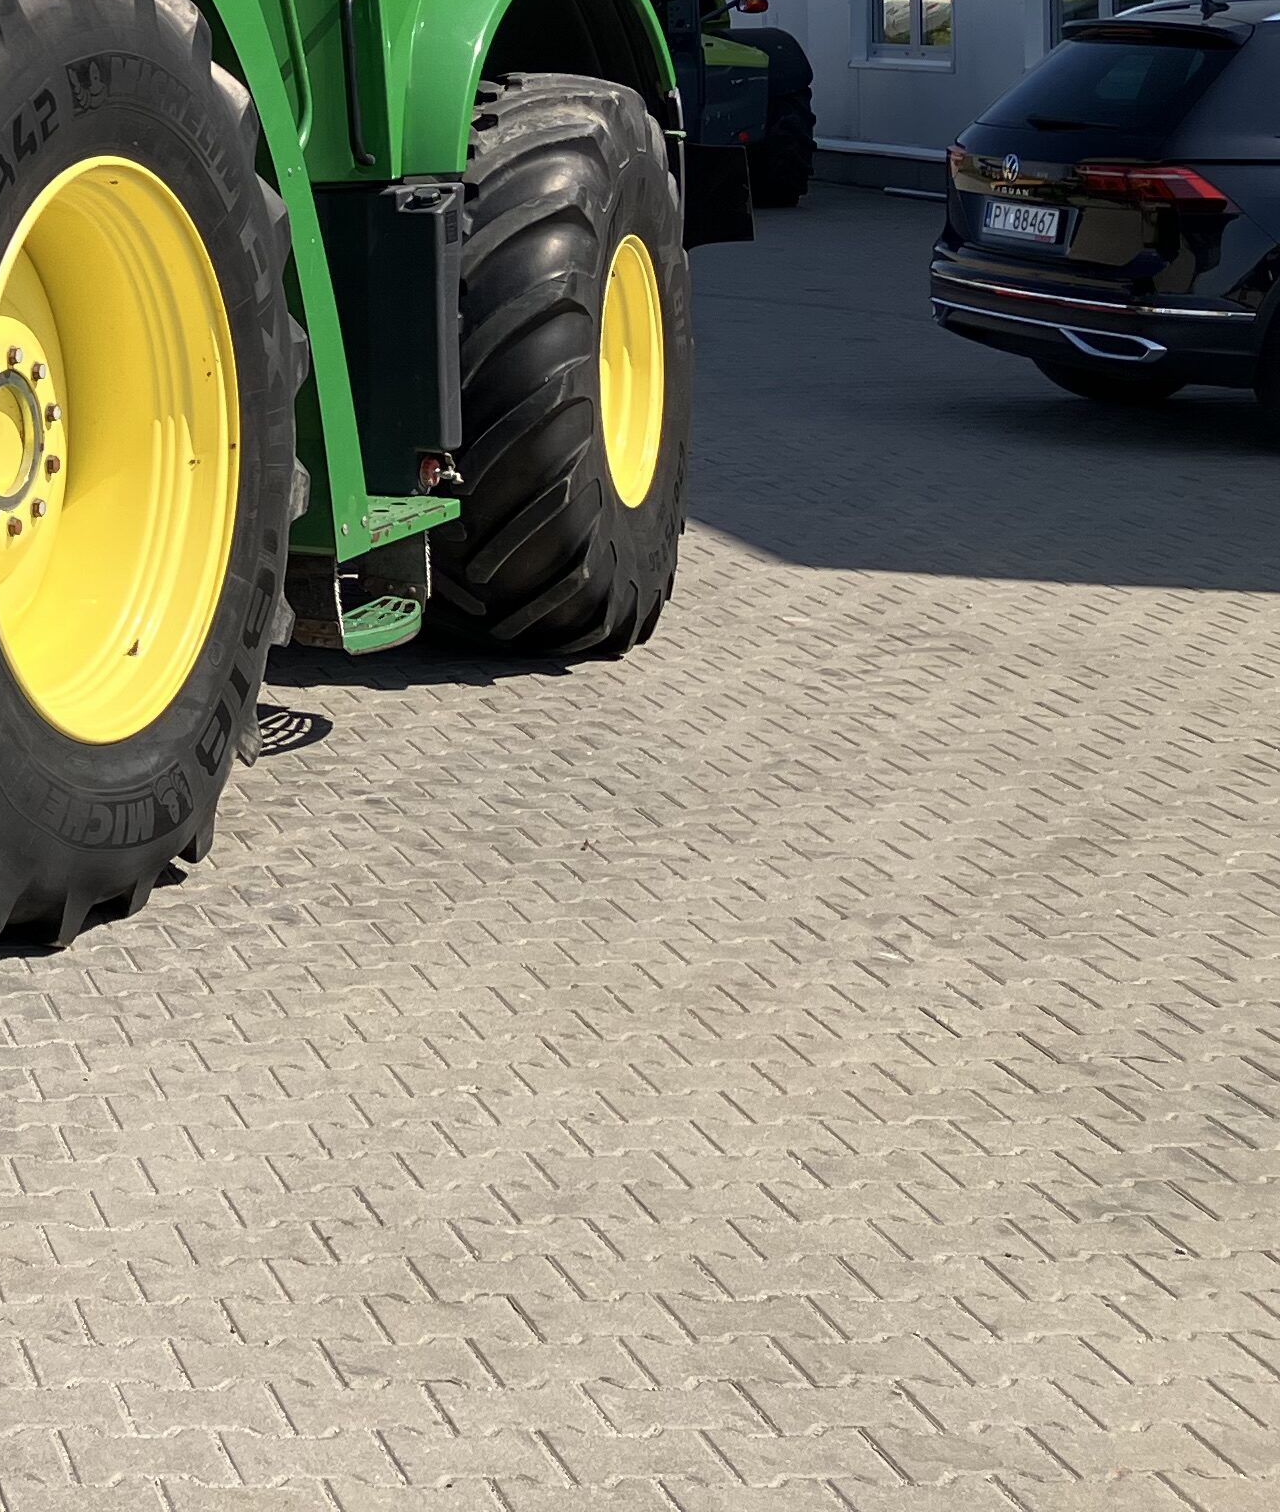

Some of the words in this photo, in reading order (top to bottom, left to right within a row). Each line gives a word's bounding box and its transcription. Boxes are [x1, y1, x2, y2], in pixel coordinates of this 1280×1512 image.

[110, 55, 243, 212] MICHELIN
[993, 206, 1010, 228] PY
[1013, 208, 1056, 235] 88467
